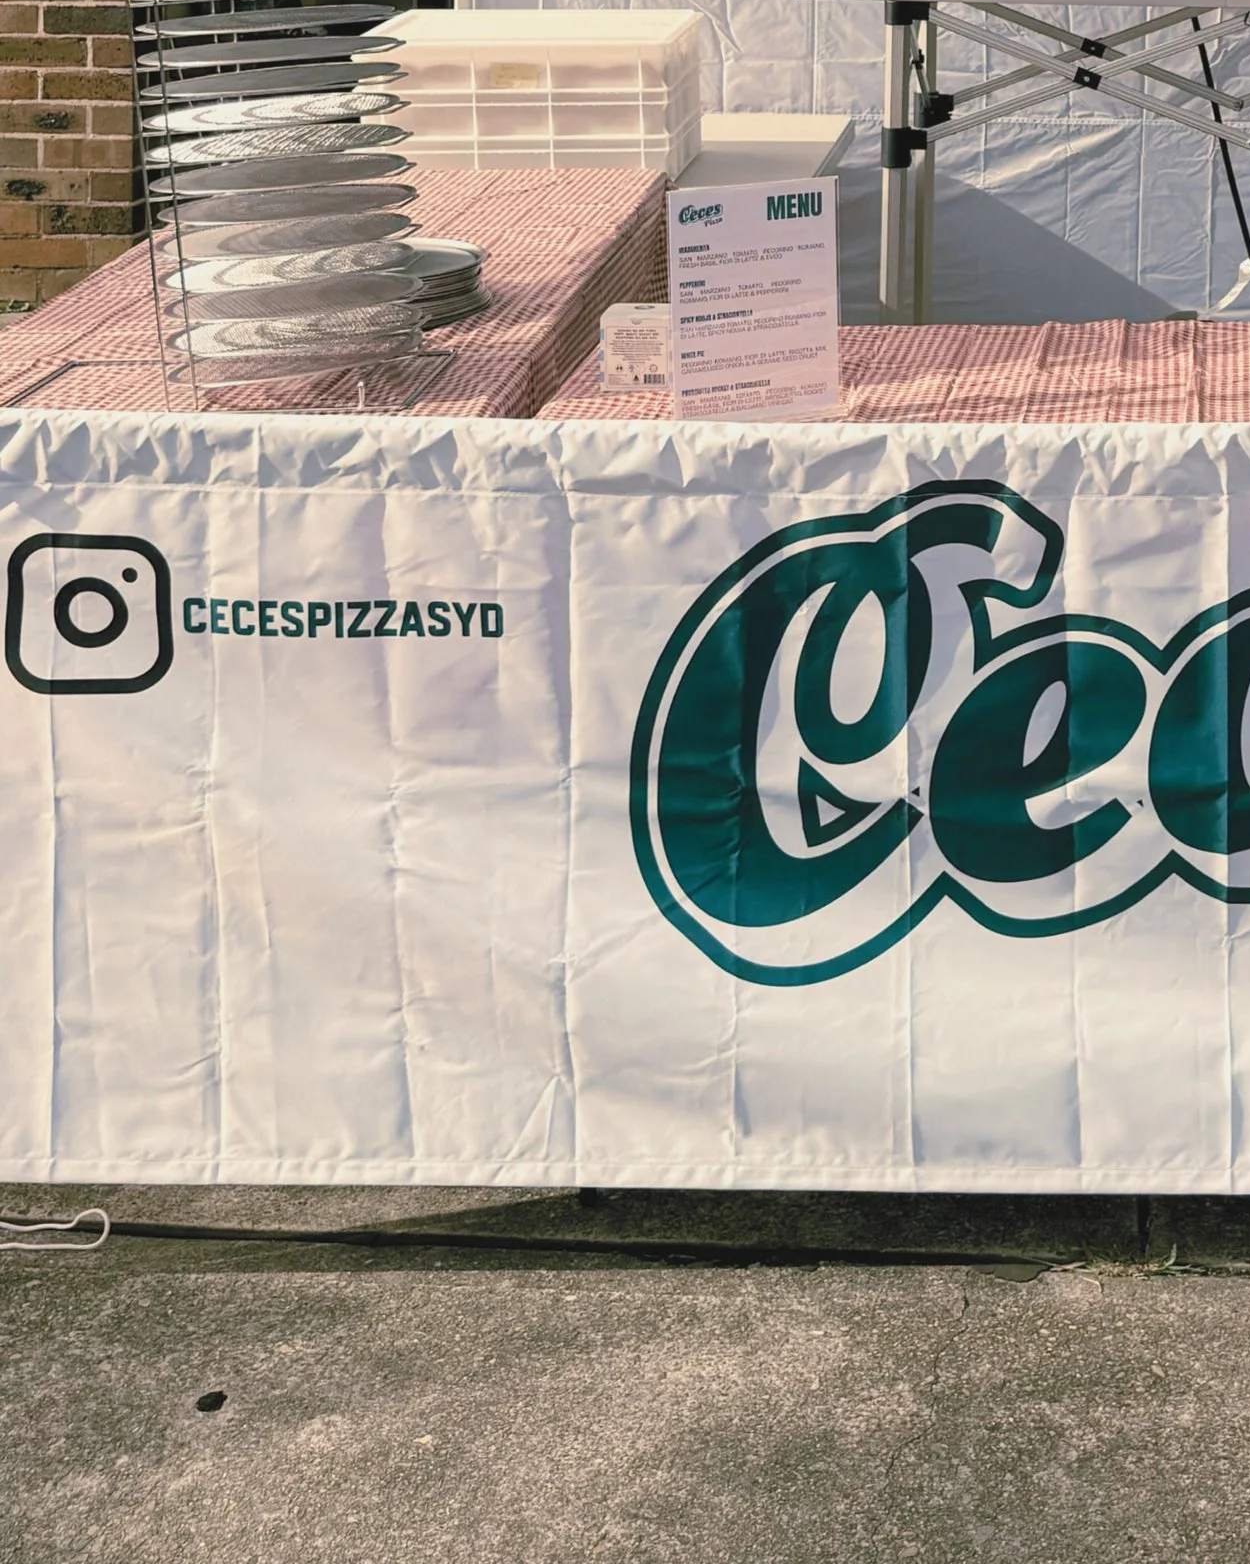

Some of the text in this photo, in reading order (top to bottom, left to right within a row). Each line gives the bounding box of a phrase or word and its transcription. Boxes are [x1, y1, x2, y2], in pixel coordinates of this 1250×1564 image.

[679, 204, 723, 225] Ceces
[767, 192, 822, 220] MENU
[183, 597, 505, 639] CECESPIZZASYD
